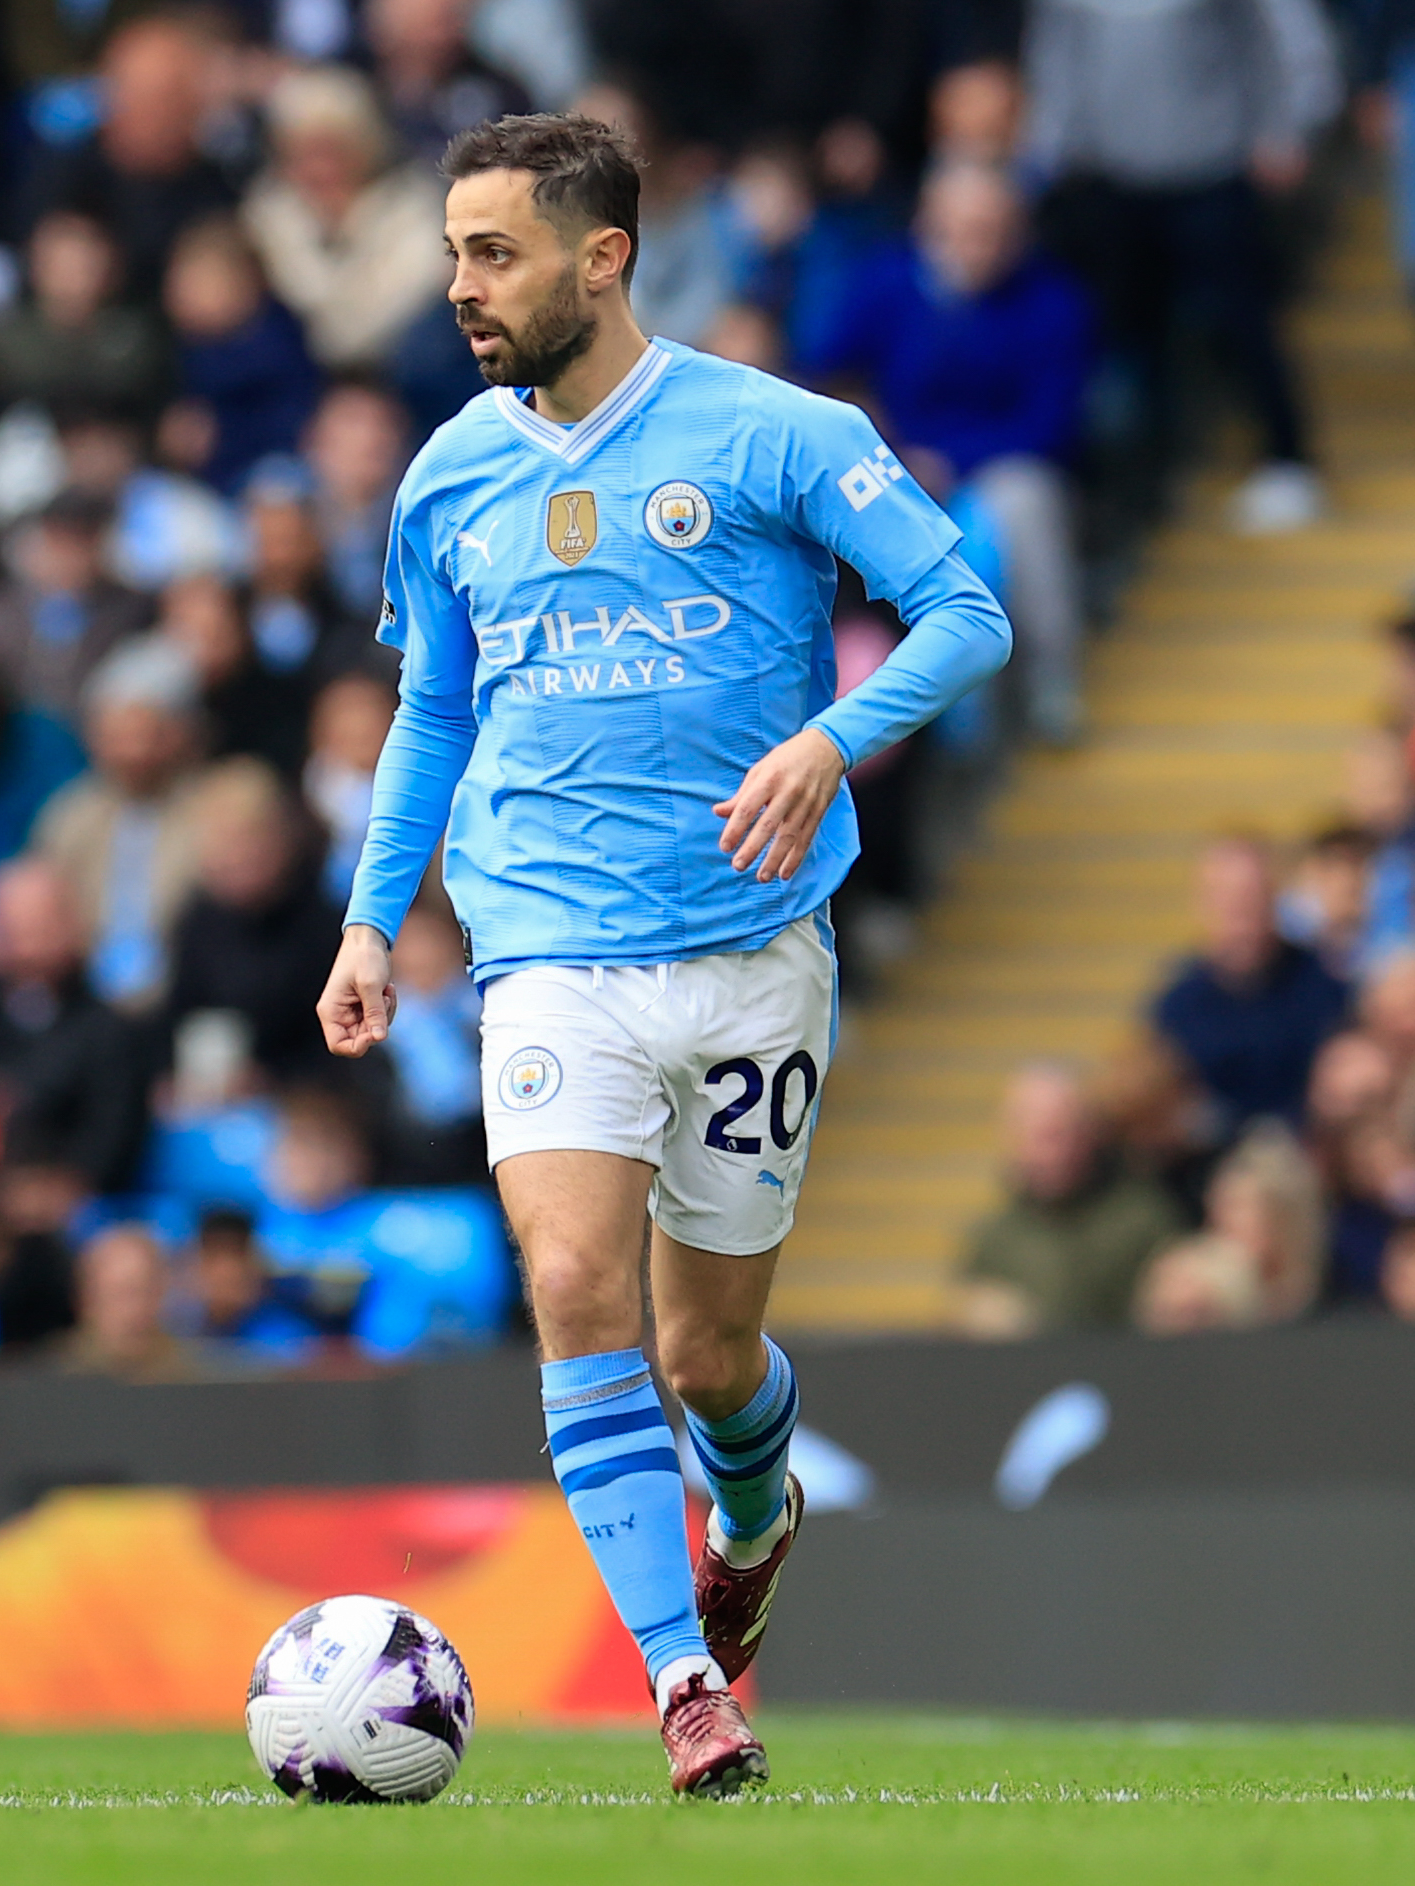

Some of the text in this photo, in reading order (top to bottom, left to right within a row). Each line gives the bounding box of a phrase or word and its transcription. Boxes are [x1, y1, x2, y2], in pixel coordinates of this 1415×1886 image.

[650, 485, 705, 508] MANCHESTER
[560, 538, 584, 550] FIFA
[671, 538, 692, 547] CITY
[476, 594, 732, 666] ETIHAD
[509, 655, 685, 696] AIRWAYS
[704, 1050, 818, 1155] 20
[582, 1512, 635, 1539] CITY
